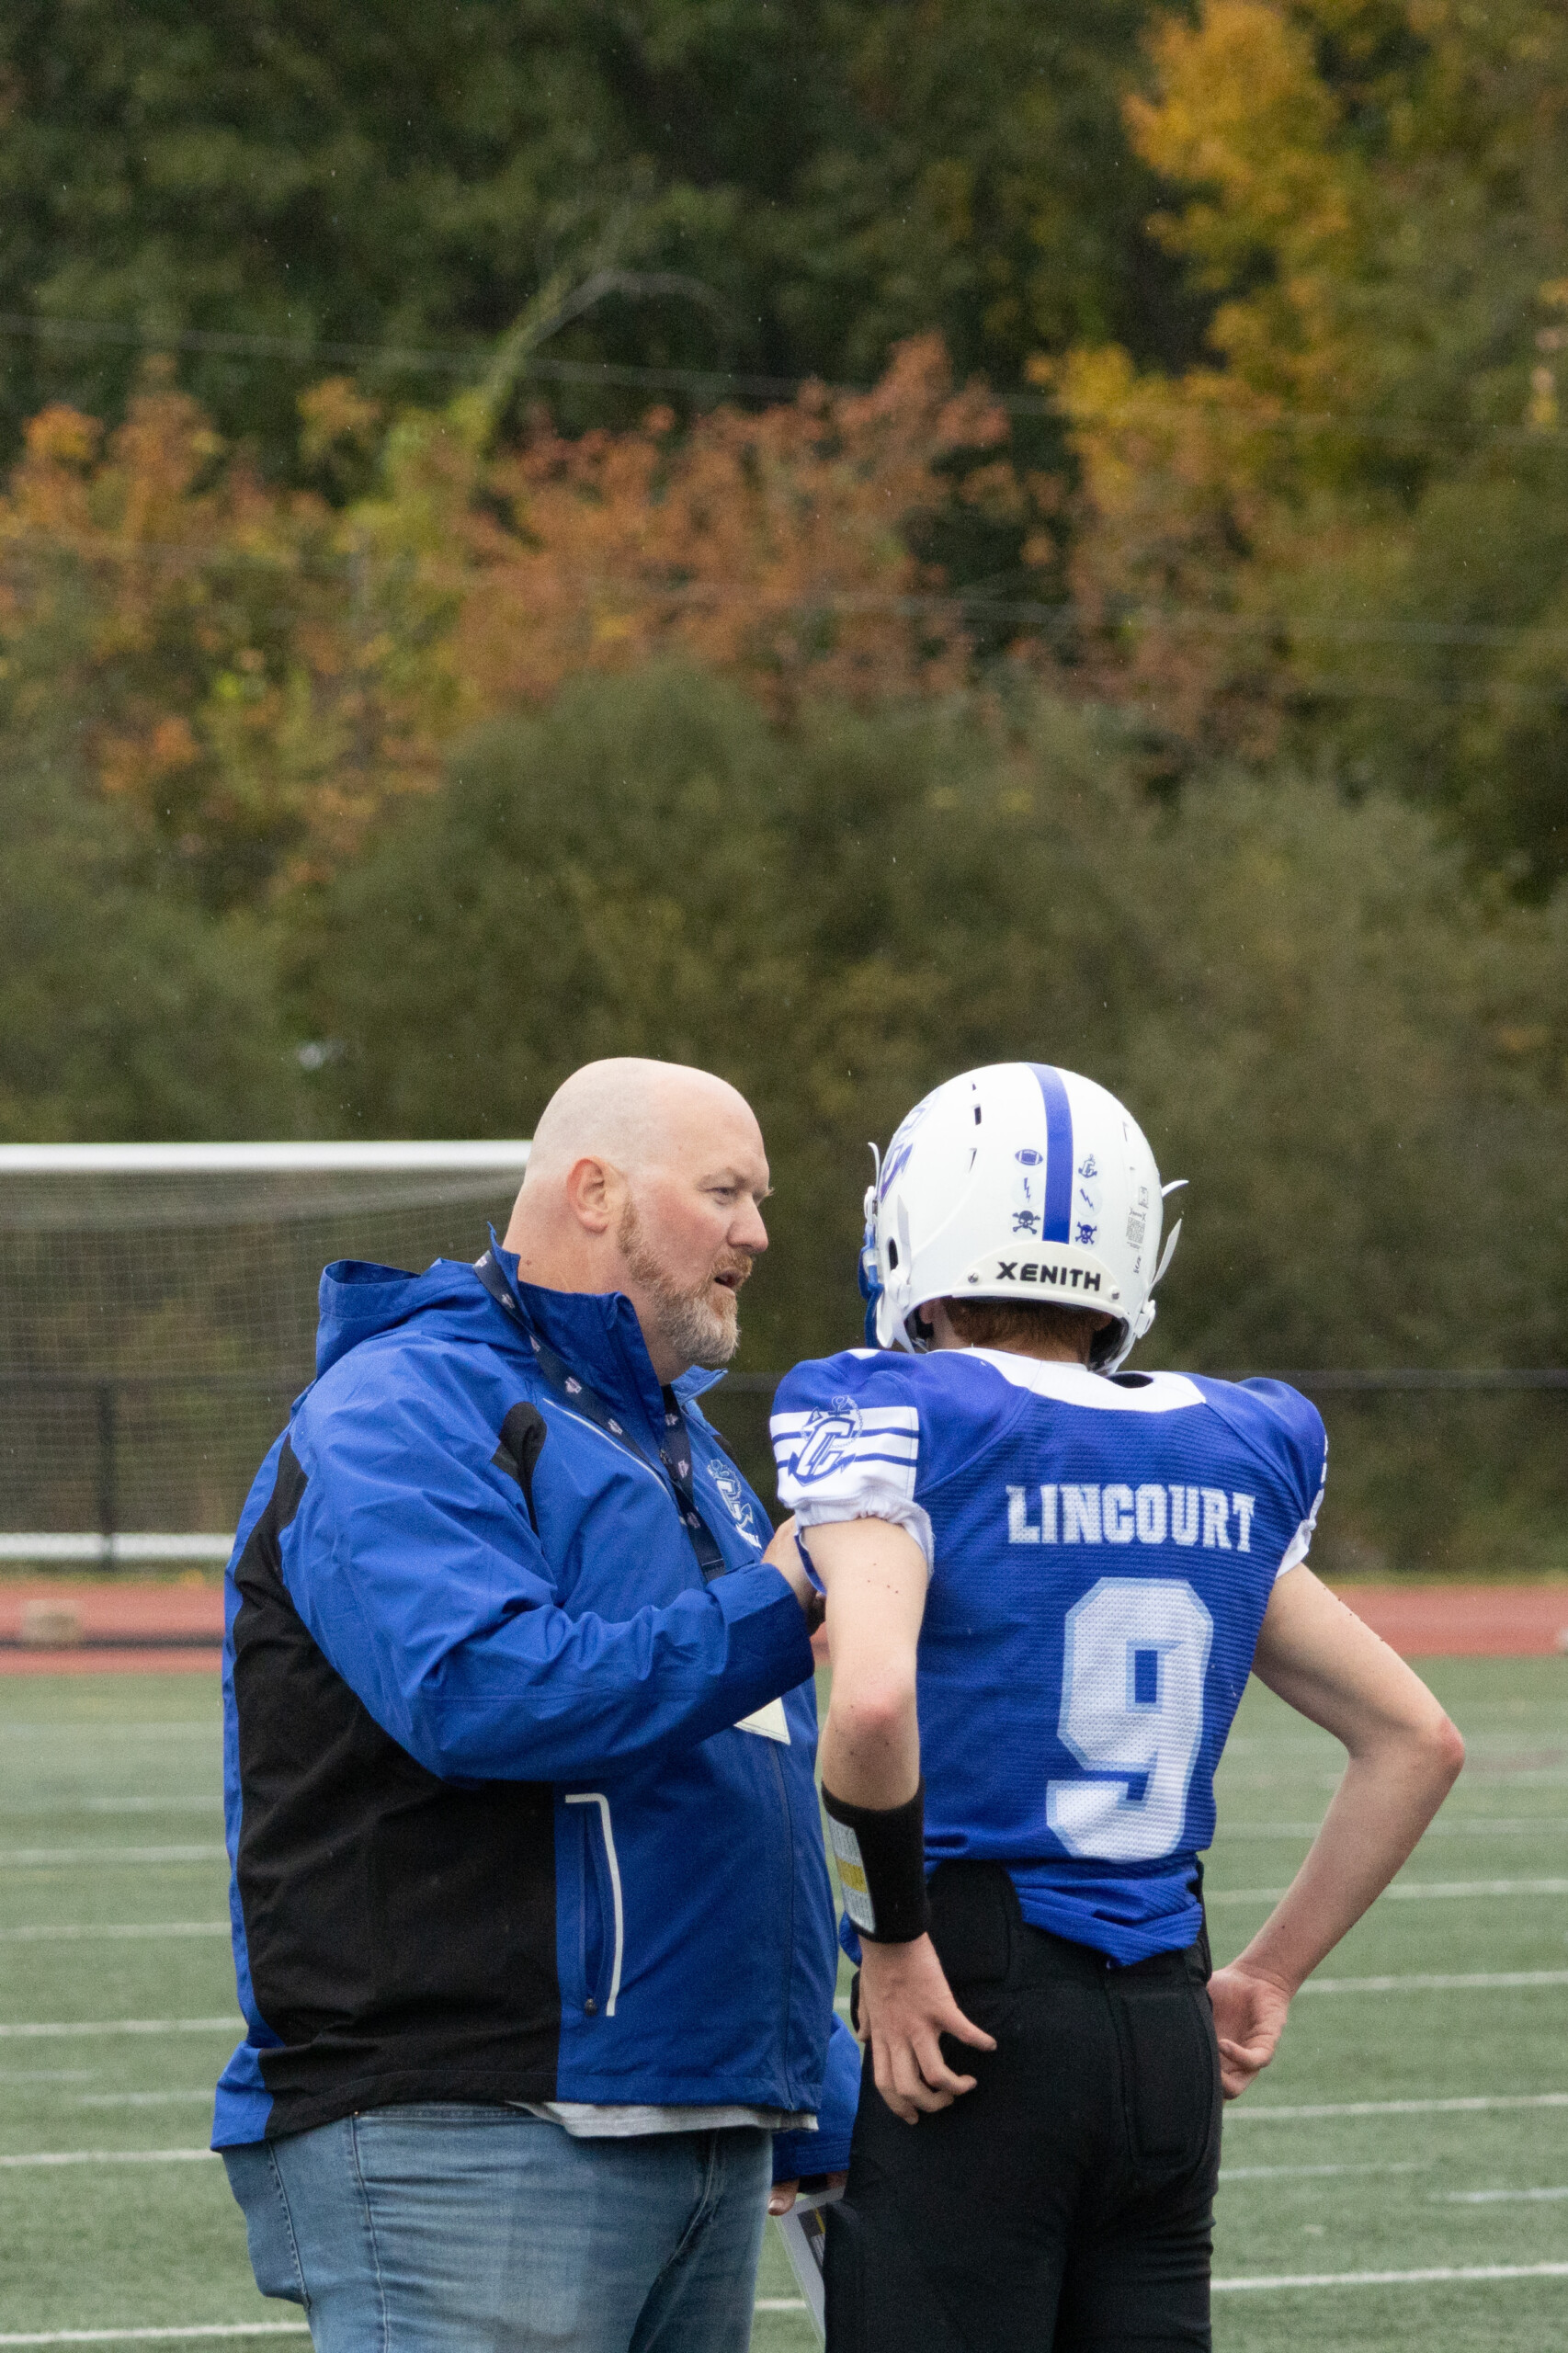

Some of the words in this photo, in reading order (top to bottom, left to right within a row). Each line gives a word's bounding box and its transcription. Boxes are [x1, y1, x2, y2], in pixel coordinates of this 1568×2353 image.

[995, 1261, 1101, 1291] XENITH
[1006, 1483, 1256, 1552] LINCOURT
[1046, 1577, 1213, 1864] 9
